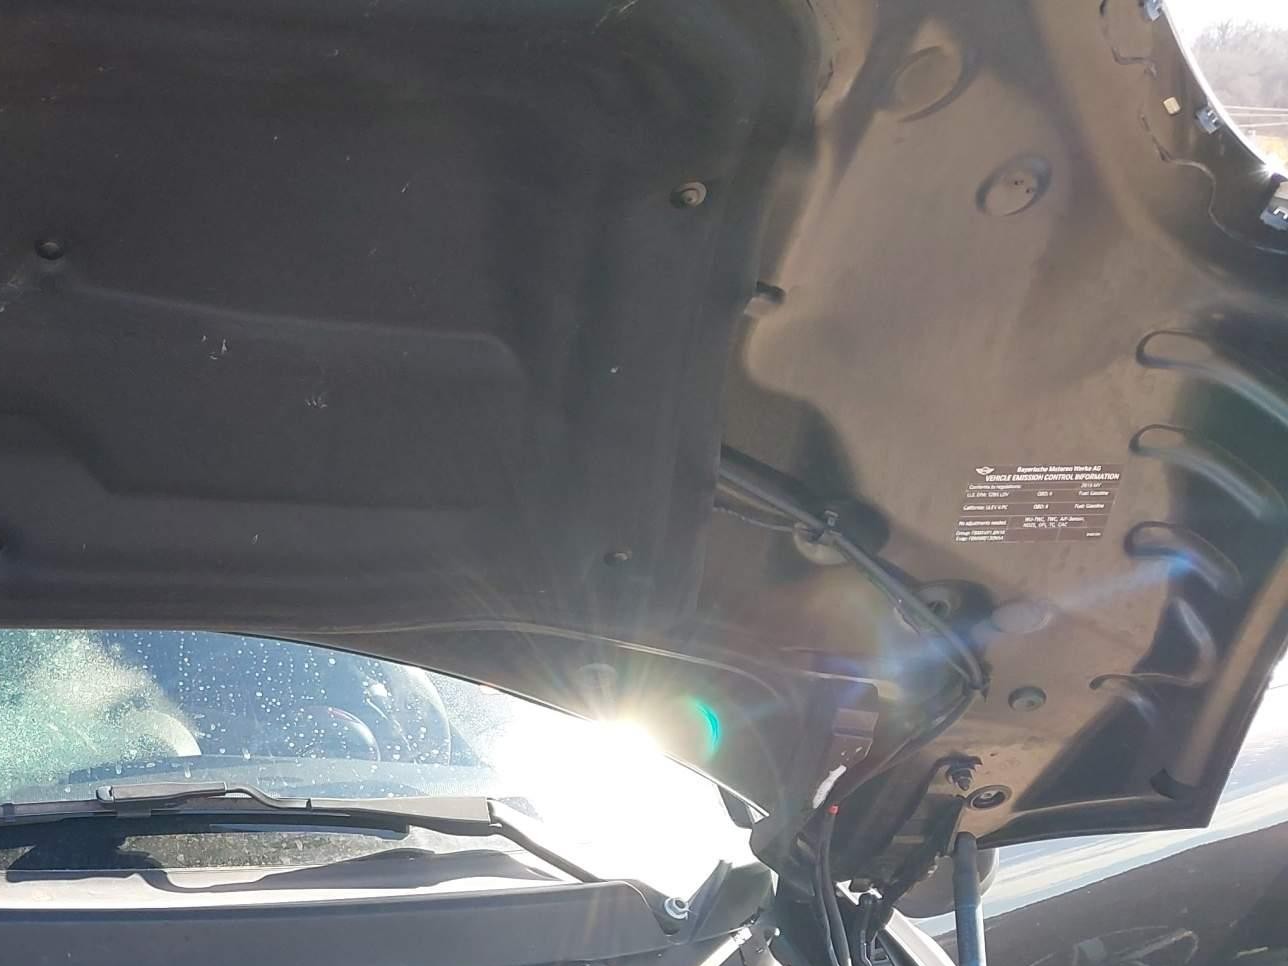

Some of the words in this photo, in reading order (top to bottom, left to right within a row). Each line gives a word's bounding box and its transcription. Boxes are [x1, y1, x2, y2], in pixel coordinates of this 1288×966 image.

[1016, 466, 1048, 474] Bayerische
[985, 474, 1012, 482] VEHICLE
[1044, 473, 1074, 481] CONTROL
